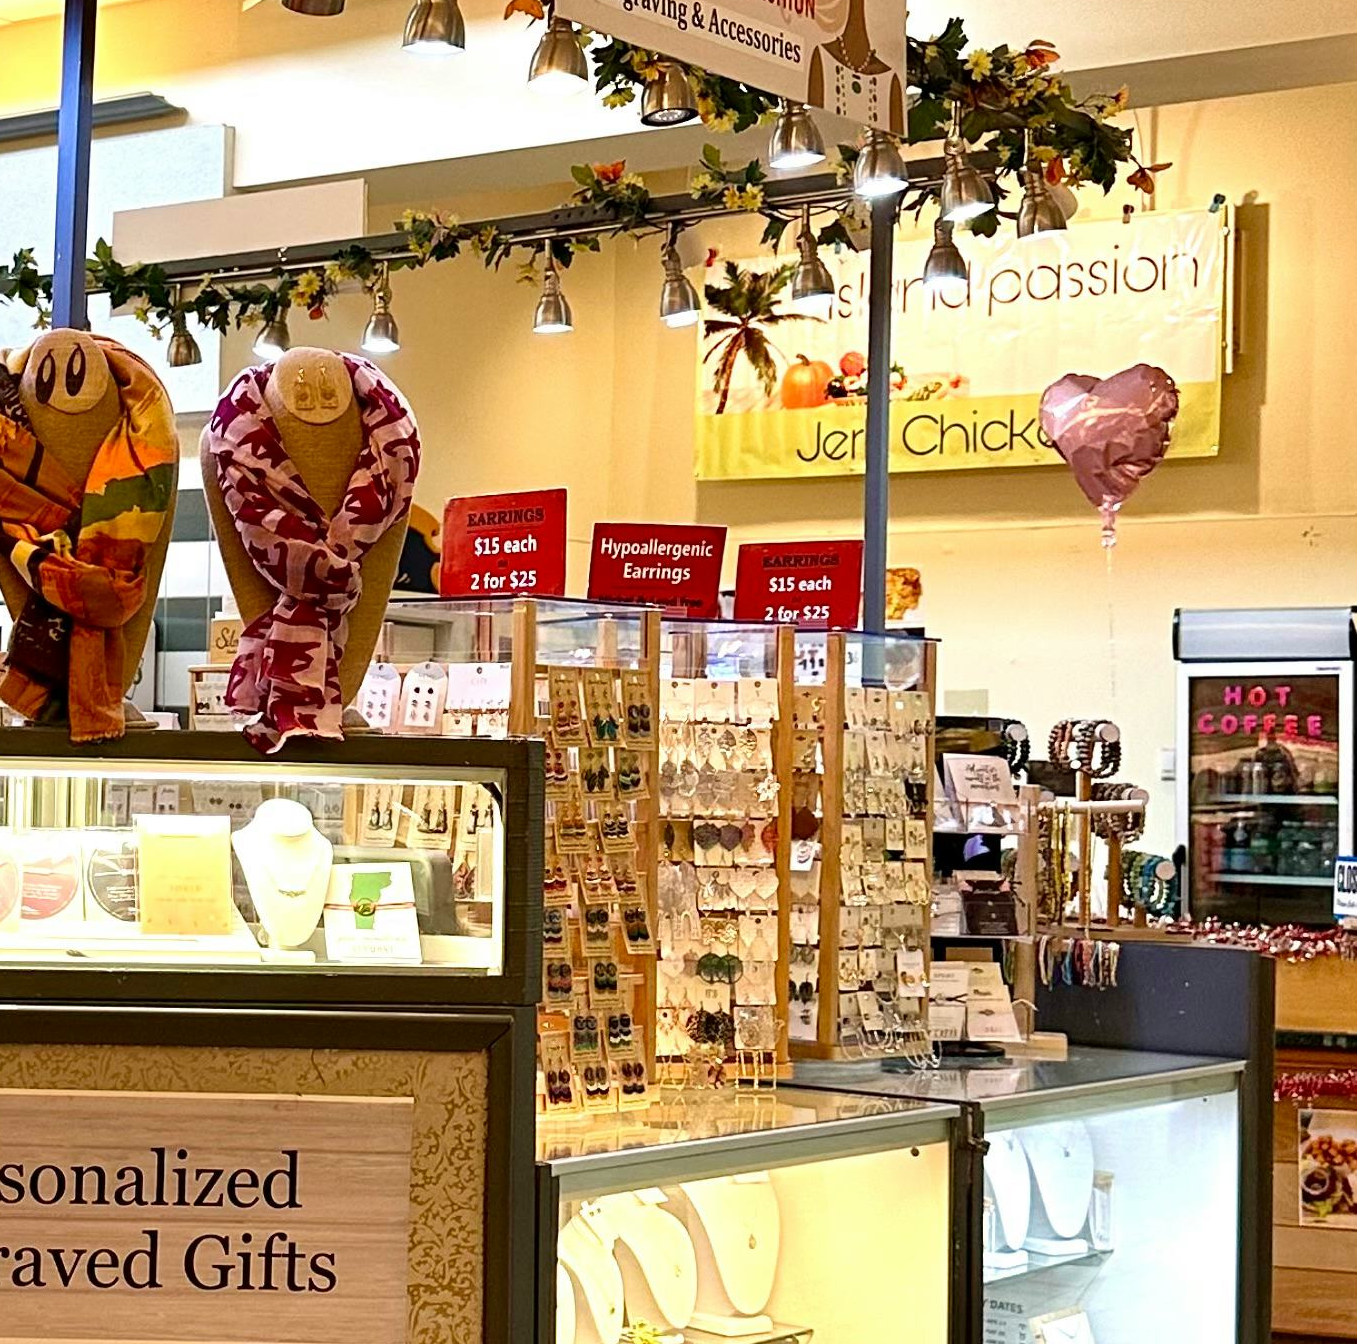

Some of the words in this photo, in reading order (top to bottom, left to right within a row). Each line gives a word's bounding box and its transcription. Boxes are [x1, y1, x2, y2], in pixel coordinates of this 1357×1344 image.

[691, 2, 705, 30] &
[709, 8, 802, 64] Accessories
[988, 245, 1199, 317] passion
[797, 421, 865, 463] Jer
[903, 409, 1054, 457] Chicke
[467, 507, 544, 527] EARRINGS
[474, 537, 500, 556] $15
[503, 534, 537, 554] each
[600, 538, 714, 561] Hypoallergenic
[762, 553, 840, 568] EARRINGS
[470, 573, 480, 590] 2
[483, 572, 506, 589] for
[509, 570, 537, 589] $25
[622, 562, 691, 585] Earrings
[769, 577, 795, 592] $15
[798, 575, 832, 591] each
[764, 607, 774, 621] 2
[778, 606, 799, 622] for
[803, 606, 830, 621] $25
[1223, 685, 1292, 707] HOT
[1197, 714, 1323, 737] COFFEE
[183, 1231, 338, 1293] Gifts
[989, 1300, 1023, 1314] DATES
